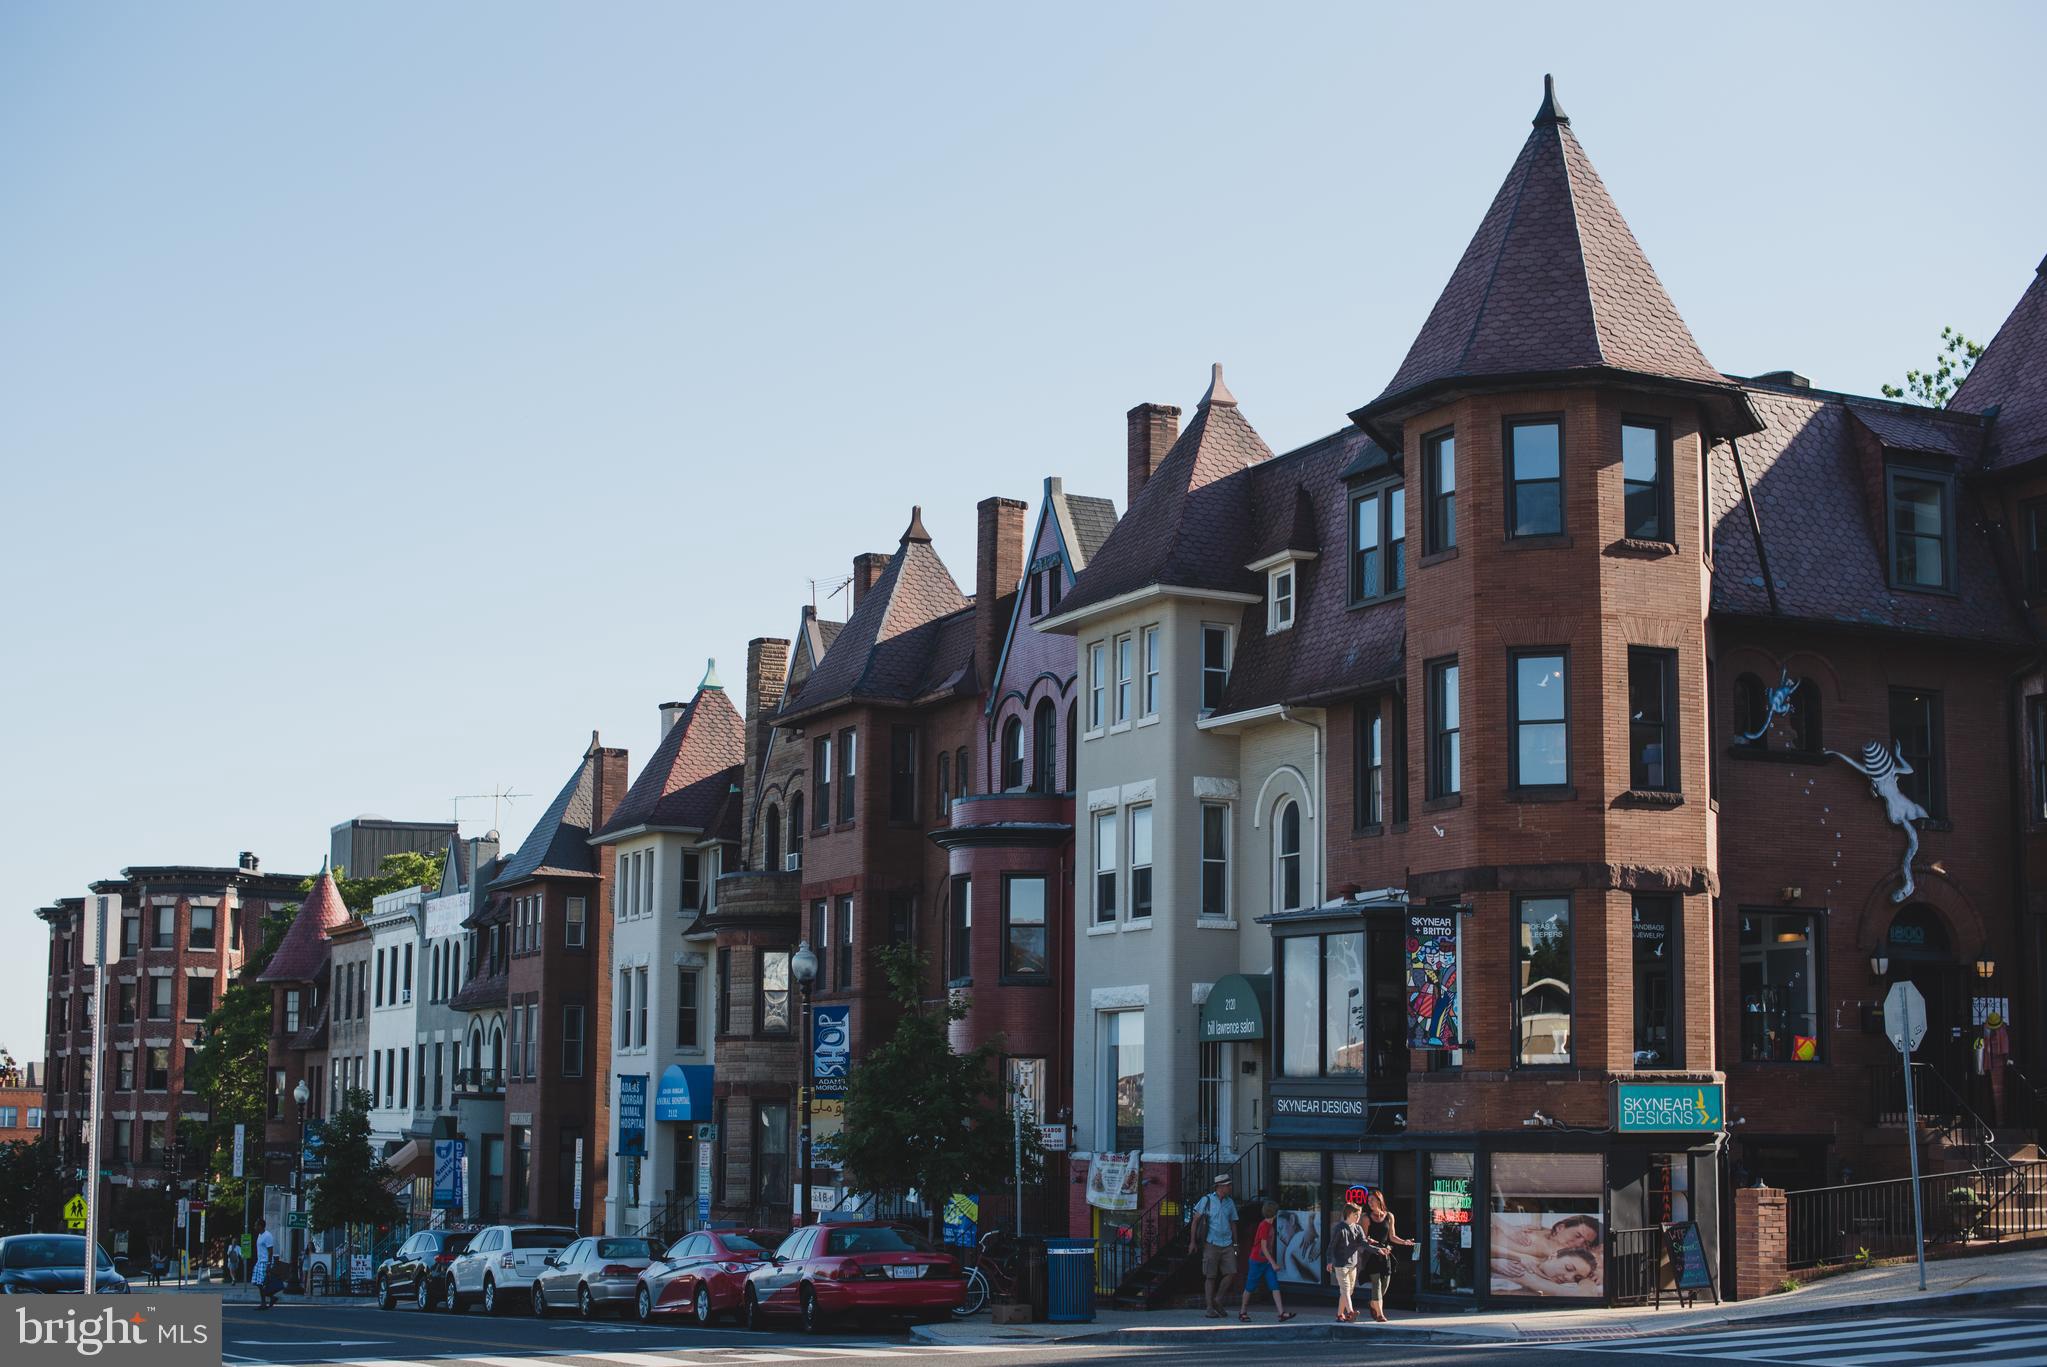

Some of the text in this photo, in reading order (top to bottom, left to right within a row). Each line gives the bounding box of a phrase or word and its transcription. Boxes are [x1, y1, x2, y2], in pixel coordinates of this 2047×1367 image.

[1411, 917, 1451, 926] SKYNEAR
[1423, 927, 1452, 936] BRITTO
[1207, 1017, 1255, 1035] bill lawrence salon
[817, 1014, 847, 1076] SHOP
[620, 1094, 644, 1106] MORGAN
[1277, 1099, 1362, 1114] SKYNEAR DESIGNS
[1624, 1097, 1693, 1111] SKYNEAR
[620, 1105, 641, 1117] ANIMAL
[1624, 1110, 1694, 1125] DESIGNS
[620, 1117, 645, 1129] HOSPITAL
[454, 1141, 464, 1206] DENTIST
[1345, 1188, 1367, 1206] OPEN
